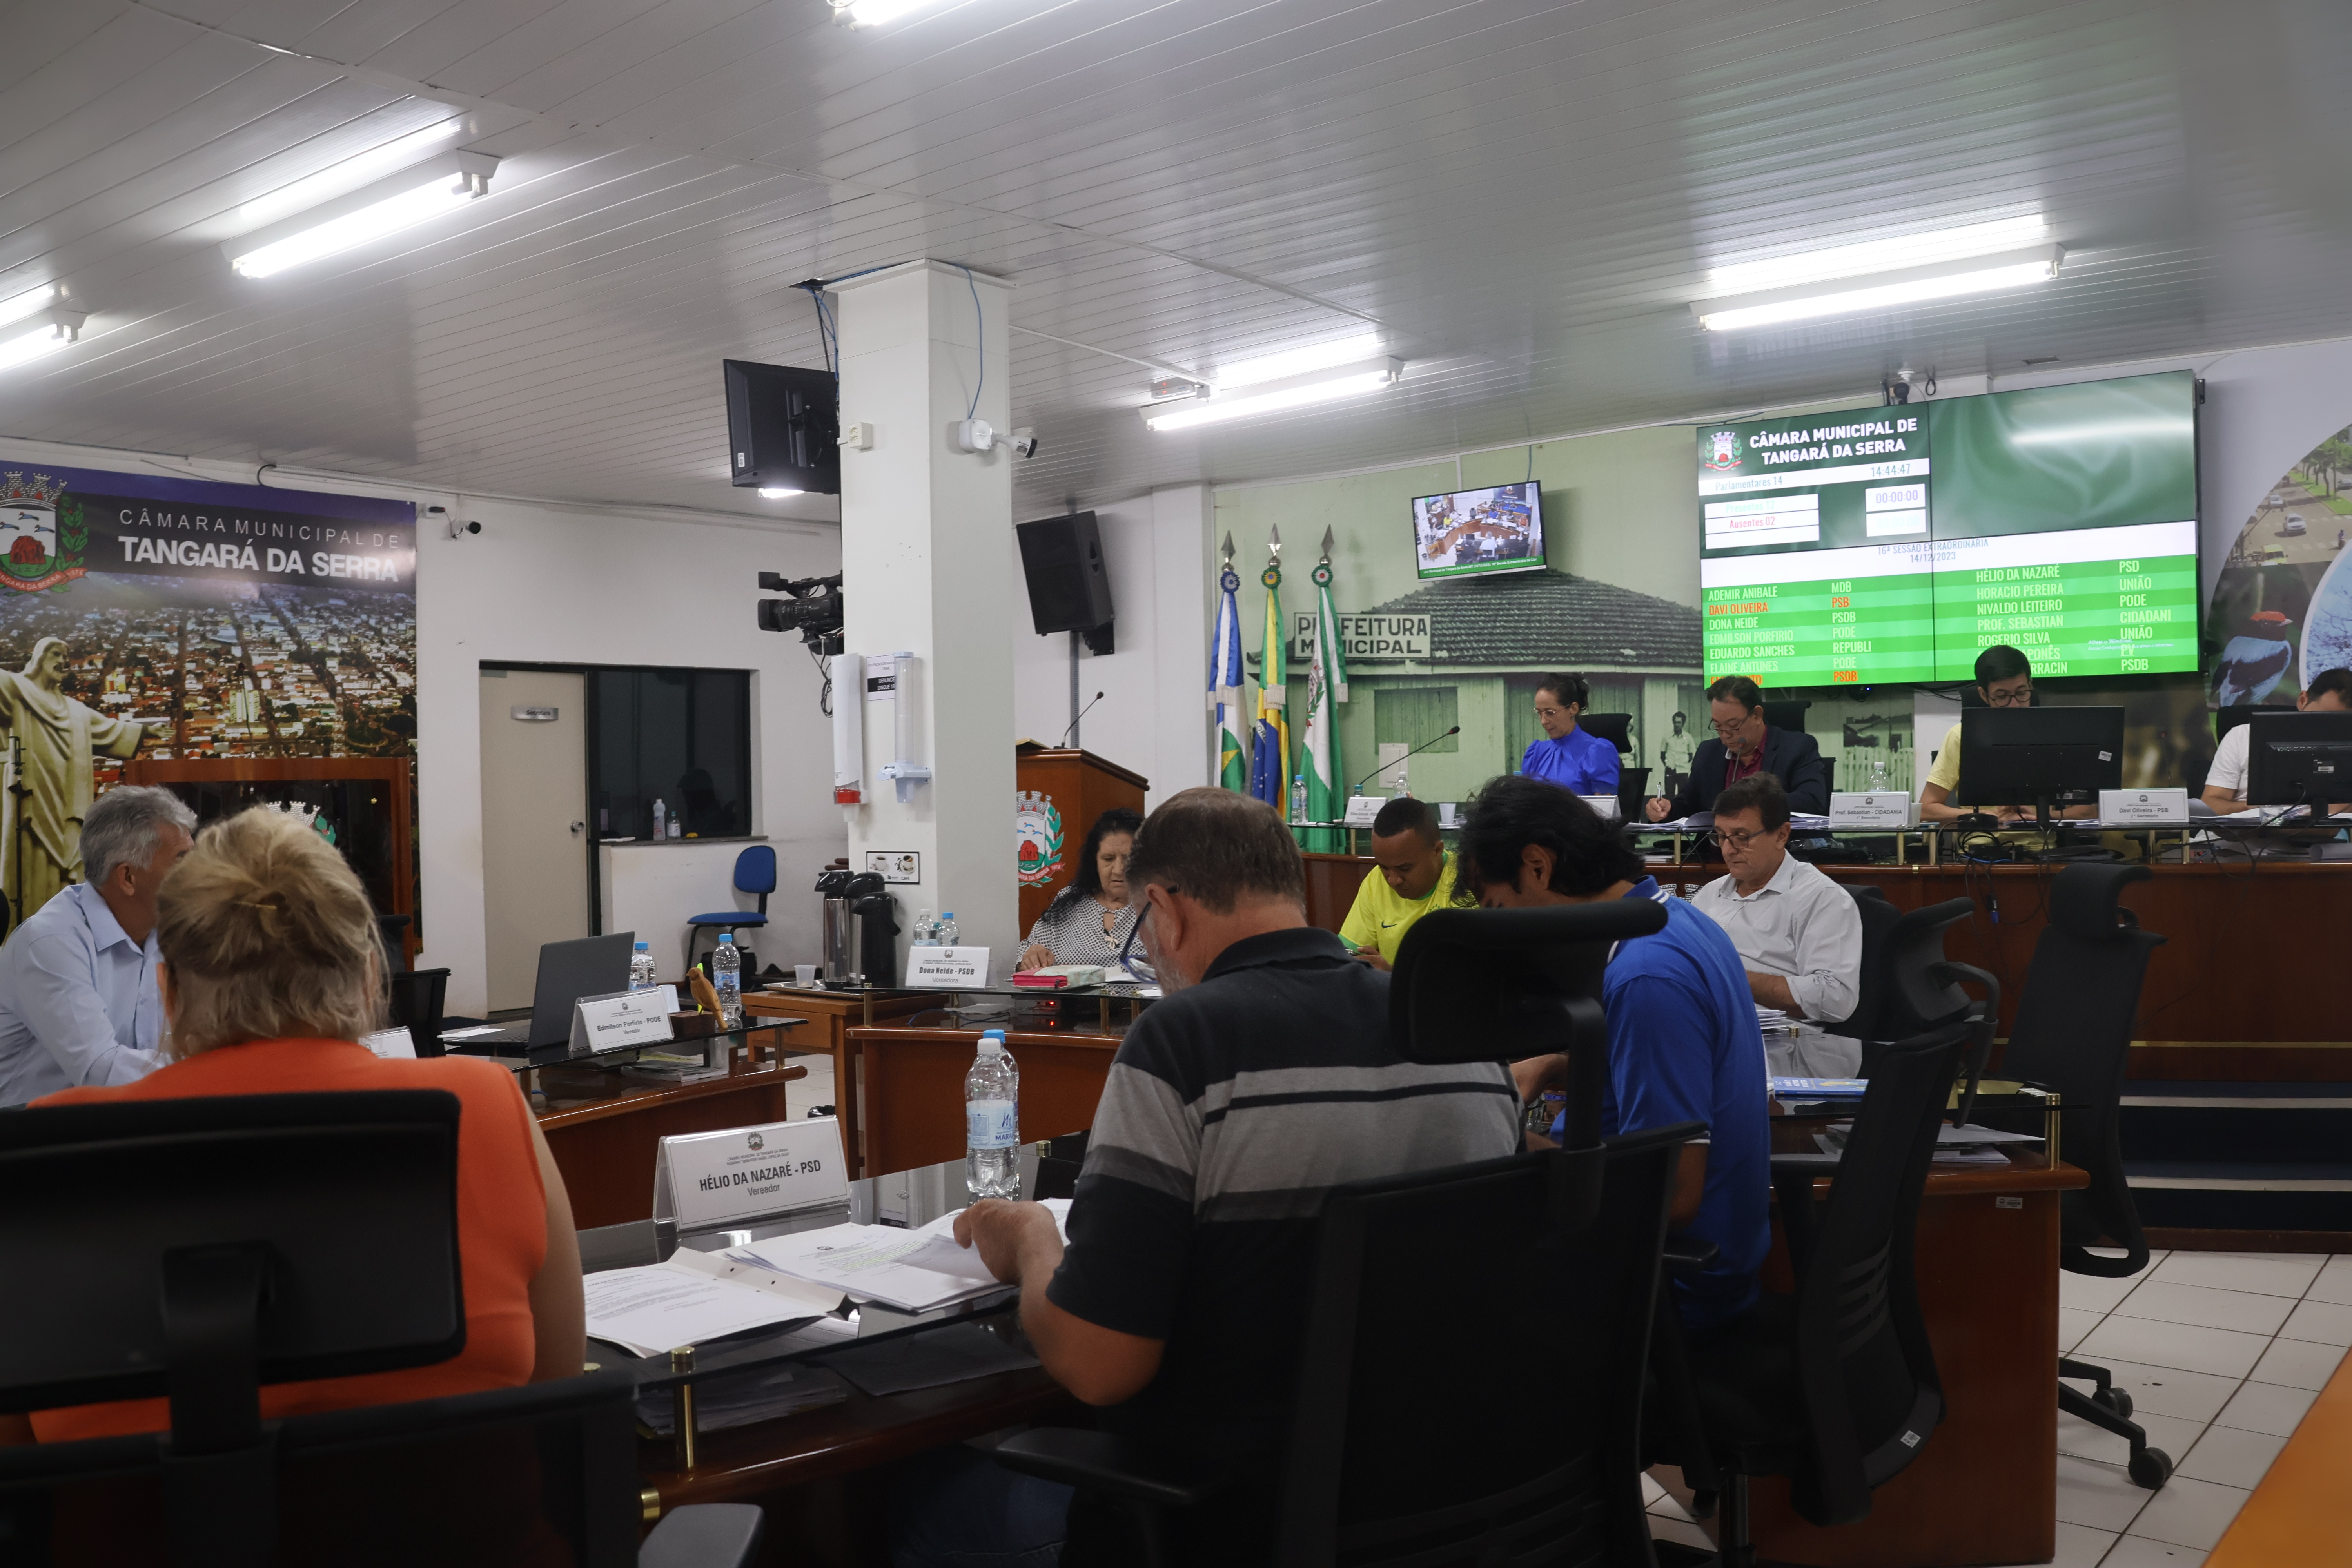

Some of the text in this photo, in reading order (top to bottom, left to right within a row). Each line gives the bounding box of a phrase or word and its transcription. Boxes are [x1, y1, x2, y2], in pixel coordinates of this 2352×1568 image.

[1750, 417, 1917, 448] CÂMARA MUNICIPAL DE
[1761, 438, 1906, 465] TANGARÁ DA SERRA
[1870, 463, 1911, 477] 14:44:47
[1716, 476, 1783, 491] Parlamentares 14
[1876, 490, 1918, 504] 00:00:00
[1726, 500, 1775, 513] Presentes 12
[120, 508, 399, 549] CÂMARA MUNICIPAL DE
[1730, 516, 1775, 529] Ausentes 02
[1878, 546, 1891, 555] 16ª
[1910, 552, 1956, 563] 14/12/2023
[118, 535, 399, 582] TANGARÁ DA SERRA
[1976, 563, 2060, 583] HÉLIO DA NAZARÉ
[2119, 560, 2140, 573] PSD
[1831, 581, 1852, 593] MDB
[2119, 575, 2152, 591] UNIÃO
[1708, 586, 1778, 601] ADEMIR ANIBALE
[1976, 583, 2064, 600] HORACIO PEREIRA
[1831, 597, 1850, 609] PSB
[1977, 599, 2062, 615] NIVALDO LEITEIRO
[2120, 593, 2147, 607] PODE
[1709, 602, 1768, 616] DAVI OLIVEIRA
[1832, 611, 1856, 624] PSDB
[1977, 615, 2063, 631] PROF. SEBASTIAN
[2120, 609, 2171, 624] CIDADANI
[1298, 617, 1428, 636] PFEITURA
[1709, 617, 1759, 631] DONA NEIDE
[1710, 630, 1794, 645] EDMILSON PORFIRIO
[1833, 626, 1856, 639] PODE
[1978, 631, 2051, 647] ROGERIO SILVA
[2120, 626, 2153, 640] UNIÃO
[1301, 639, 1422, 654] MICIPAL
[1710, 644, 1795, 659] EDUARDO SANCHES
[1833, 640, 1872, 654] REPUBLI
[2120, 644, 2135, 656] PV
[1710, 659, 1779, 674] ELAINE ANTUNES
[1833, 656, 1857, 669] PODE
[2121, 659, 2149, 671] PSDB
[1833, 670, 1858, 682] PSDB
[699, 1174, 730, 1191] HÉLIO
[733, 1172, 748, 1185] DA
[750, 1161, 793, 1183] NAZARÉ
[800, 1160, 821, 1174] PSD
[747, 1183, 780, 1196] Vereador
